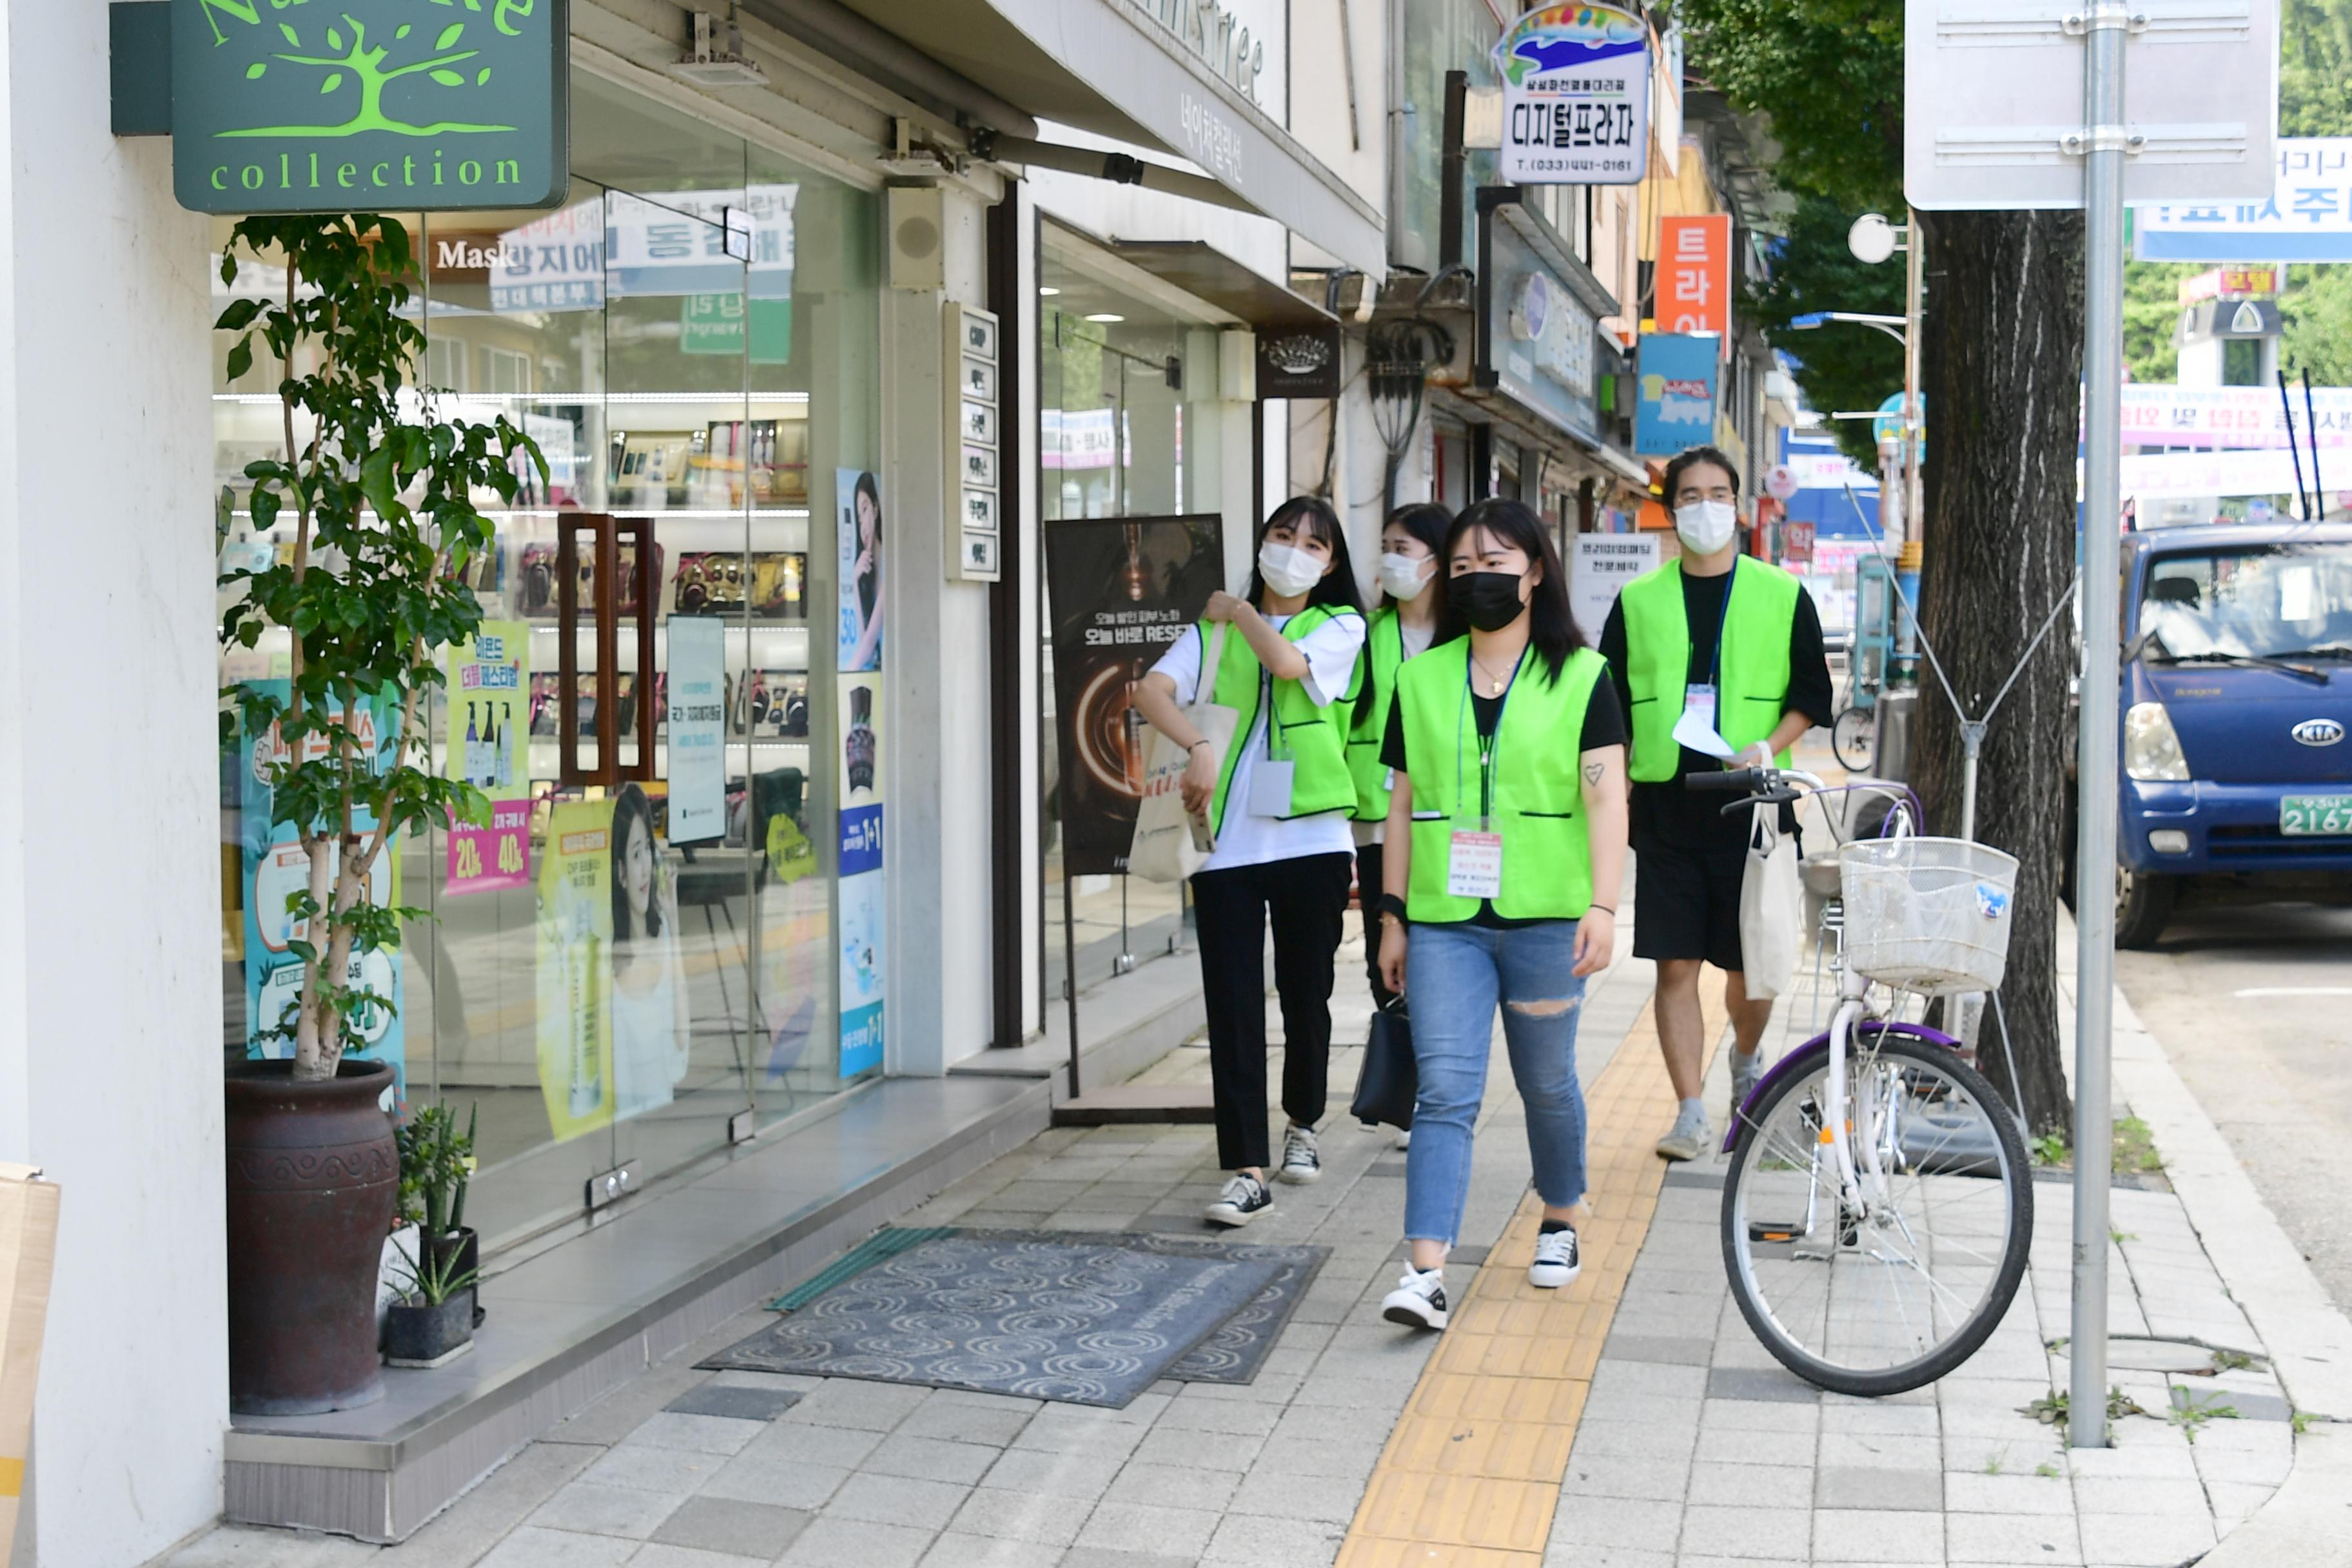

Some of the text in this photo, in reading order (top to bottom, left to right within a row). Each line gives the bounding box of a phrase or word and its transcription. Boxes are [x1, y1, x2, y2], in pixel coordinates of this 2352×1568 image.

[1512, 104, 1633, 148] 디지털프라자
[211, 150, 521, 190] collection
[436, 240, 517, 269] Mask
[1085, 628, 1113, 645] 오늘
[1115, 626, 1144, 645] 바로
[2302, 725, 2337, 741] KIA
[863, 816, 881, 852] 1+1
[2285, 808, 2352, 834] 2167
[456, 838, 482, 879] 20%
[498, 834, 524, 874] 40%
